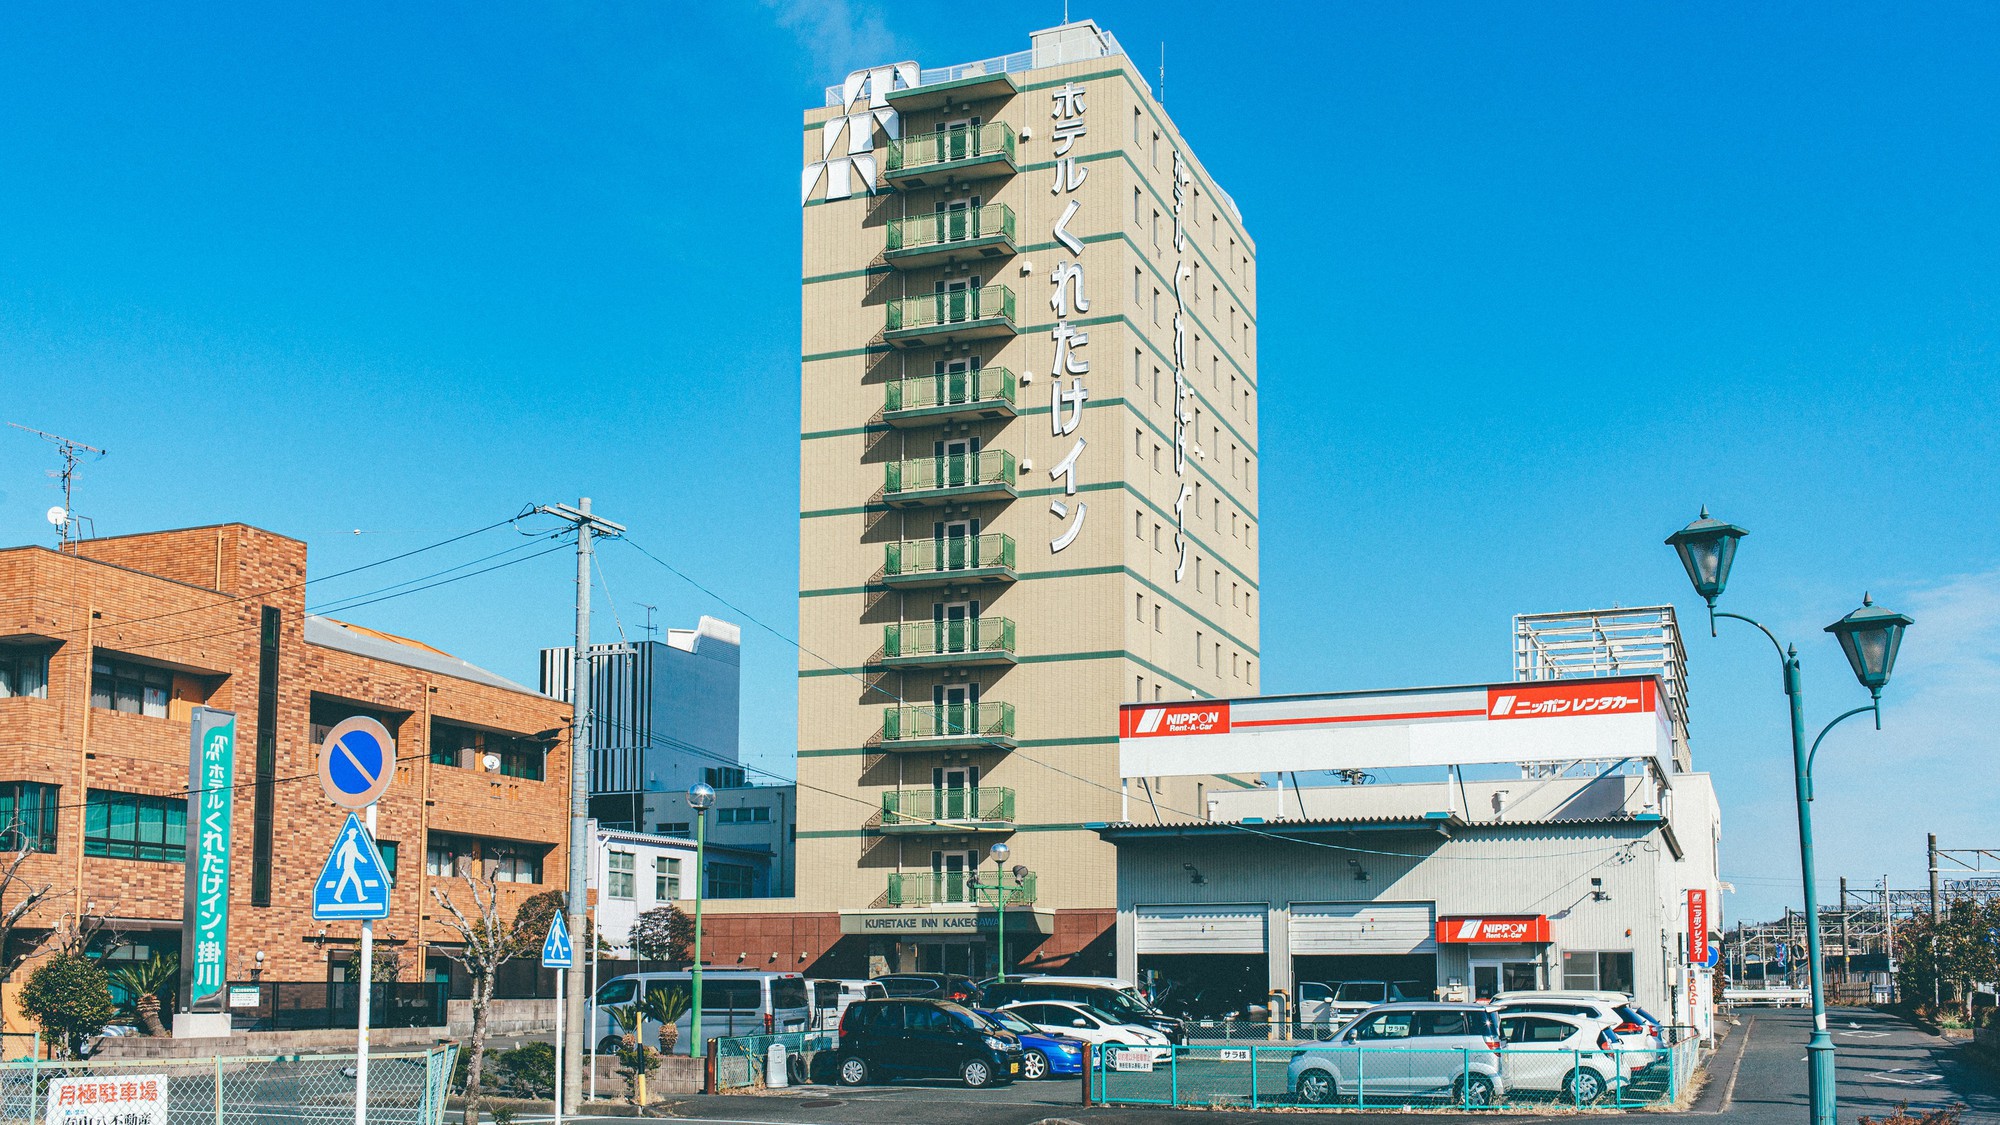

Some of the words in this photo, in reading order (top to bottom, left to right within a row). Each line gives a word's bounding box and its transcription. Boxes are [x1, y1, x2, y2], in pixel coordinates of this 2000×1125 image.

[1166, 712, 1219, 725] NIPPON
[865, 918, 917, 929] KURETAKE
[921, 917, 938, 928] INN
[943, 917, 999, 928] KAKEGAWA
[1483, 923, 1527, 933] NIPPON
[1223, 1050, 1247, 1060] サラ様
[58, 1080, 158, 1106] 月極駐車場
